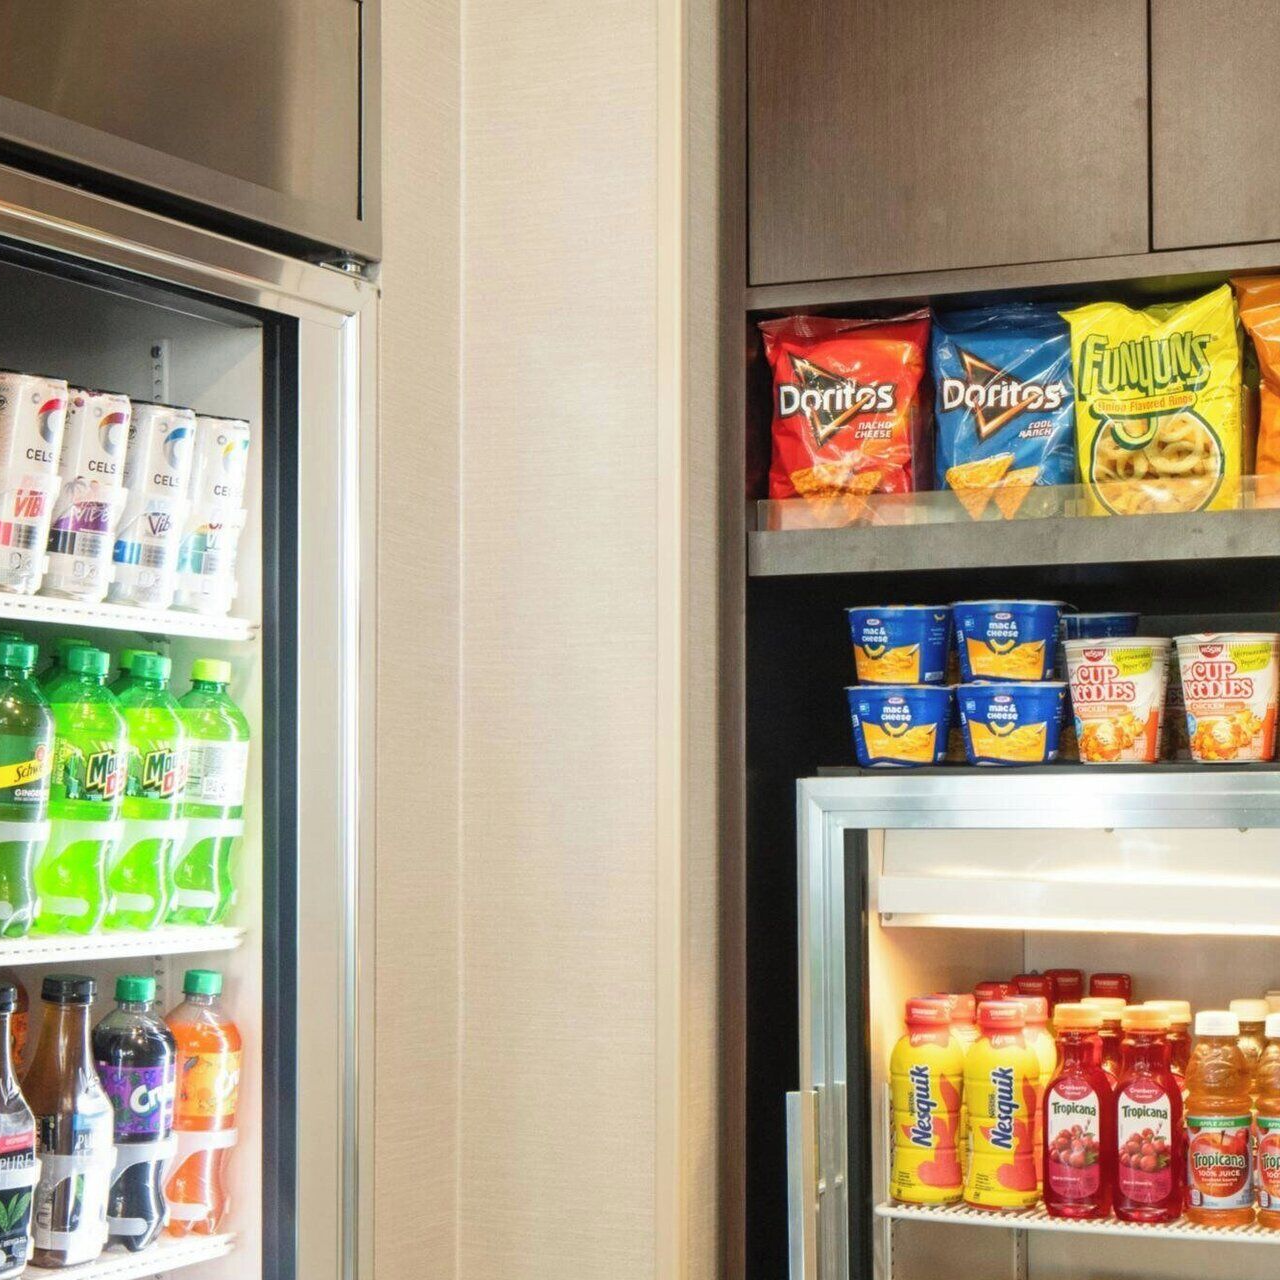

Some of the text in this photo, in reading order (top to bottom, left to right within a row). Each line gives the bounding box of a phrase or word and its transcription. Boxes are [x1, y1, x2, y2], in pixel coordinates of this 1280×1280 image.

[779, 383, 895, 417] Doritos
[942, 377, 1067, 412] Doritos
[854, 430, 892, 439] CHEESE
[858, 421, 893, 430] NACHO
[1077, 665, 1120, 684] CUP
[1192, 662, 1237, 681] CUP
[1185, 678, 1254, 701] NOODLES
[910, 1065, 932, 1147] Nesquik
[991, 1066, 1020, 1149] Nesquik
[1052, 1102, 1096, 1117] Tropicana
[1122, 1105, 1168, 1119] Tropicana
[1193, 1153, 1246, 1168] Tropicana
[1219, 1169, 1241, 1178] JUICE
